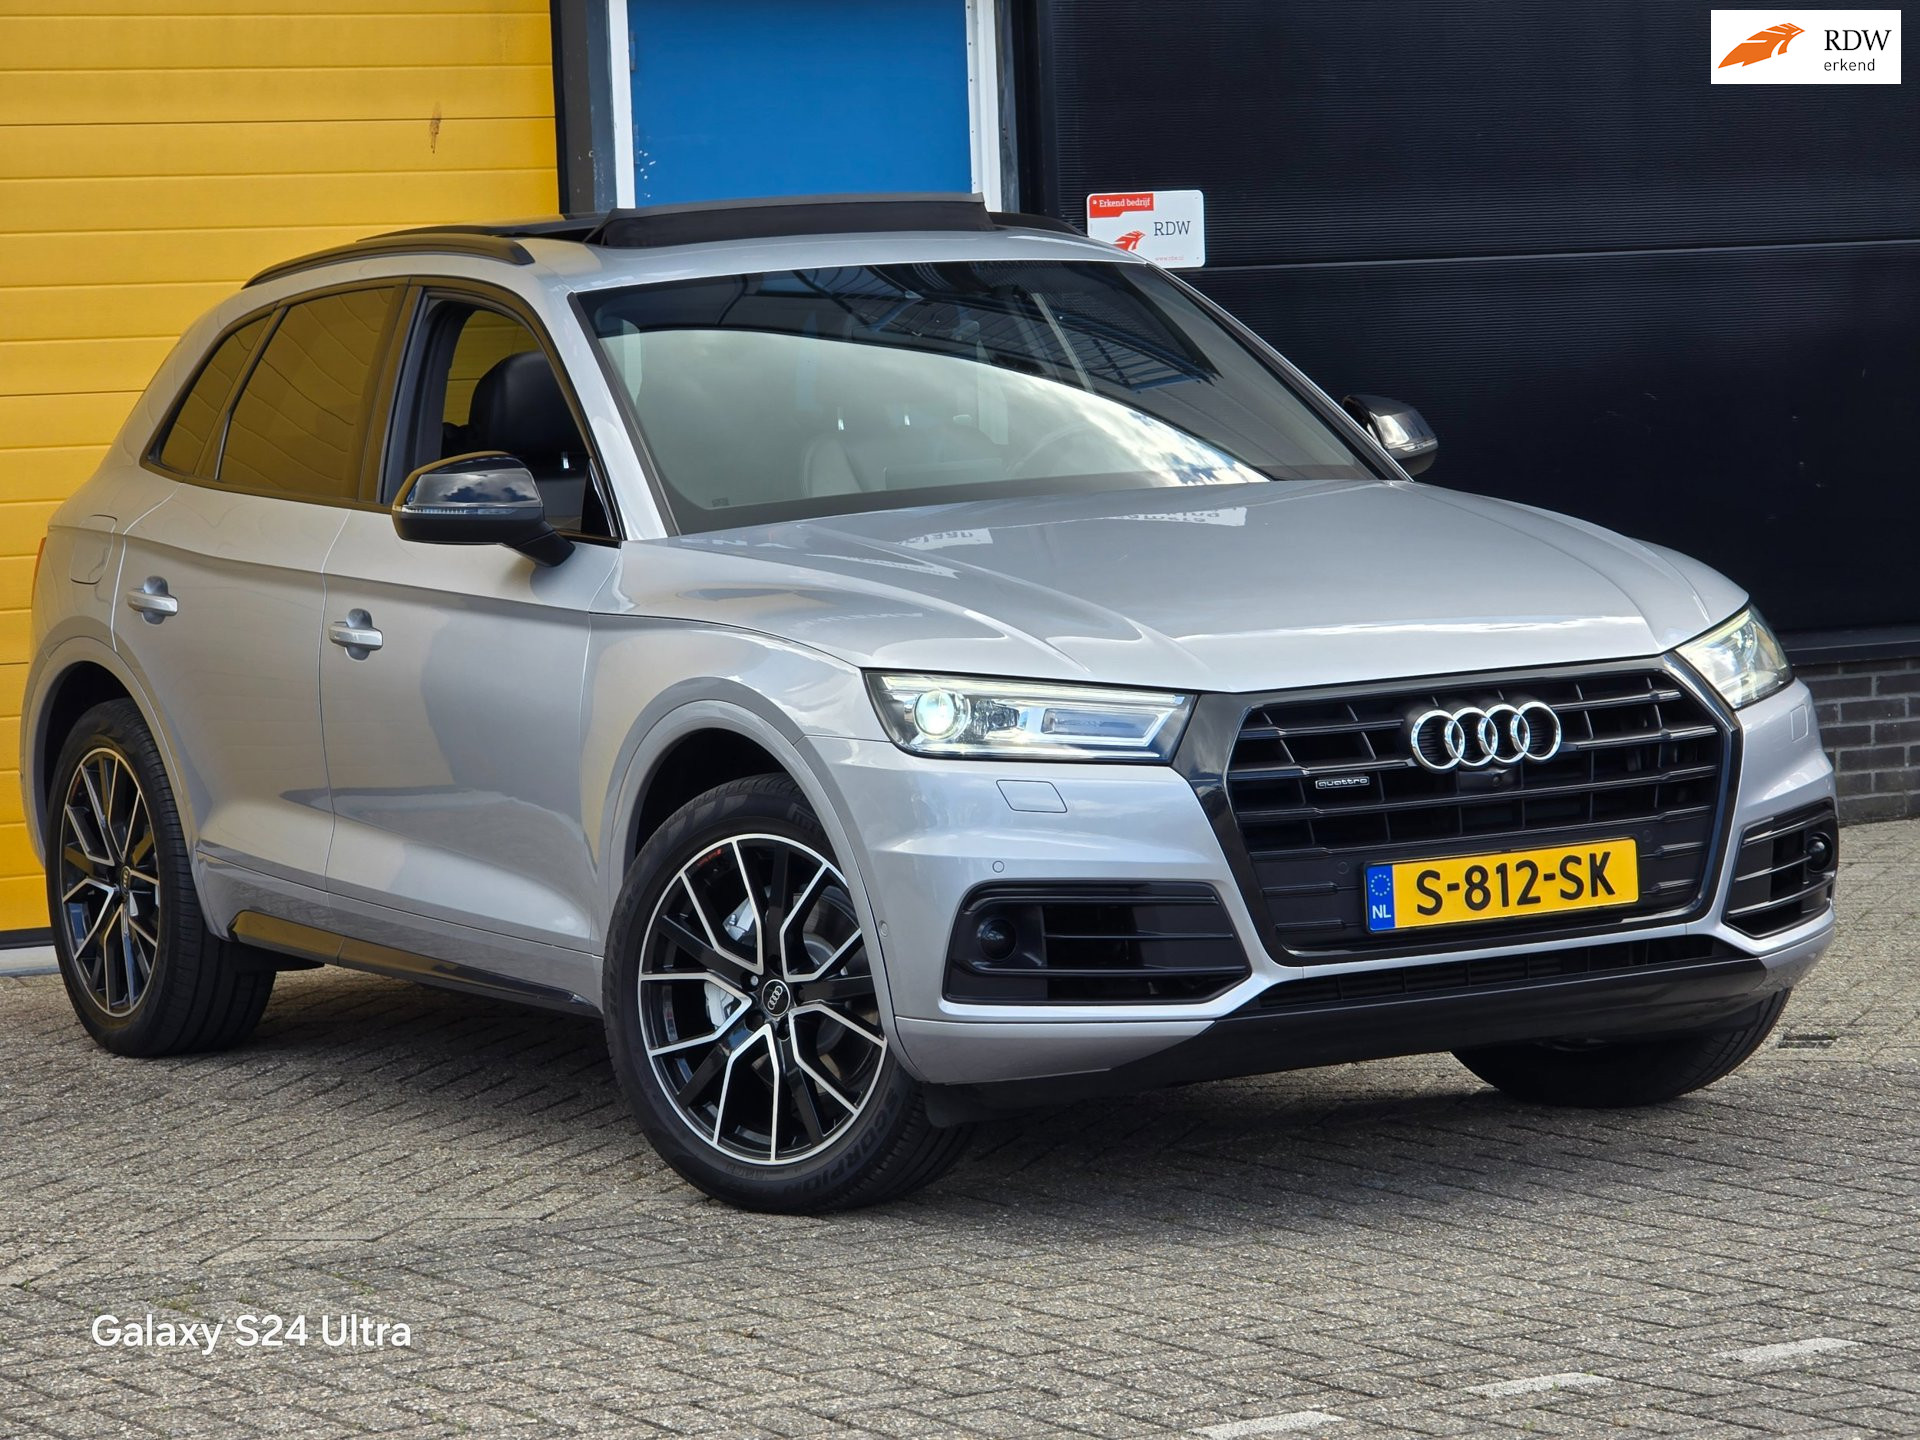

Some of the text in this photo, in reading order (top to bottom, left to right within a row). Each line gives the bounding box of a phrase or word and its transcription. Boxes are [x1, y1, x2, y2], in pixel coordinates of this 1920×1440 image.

[1099, 197, 1151, 208] Erkend bedrijf
[1153, 220, 1191, 237] RDW
[1318, 777, 1369, 789] quattro
[1372, 851, 1616, 919] NL S-812-SK
